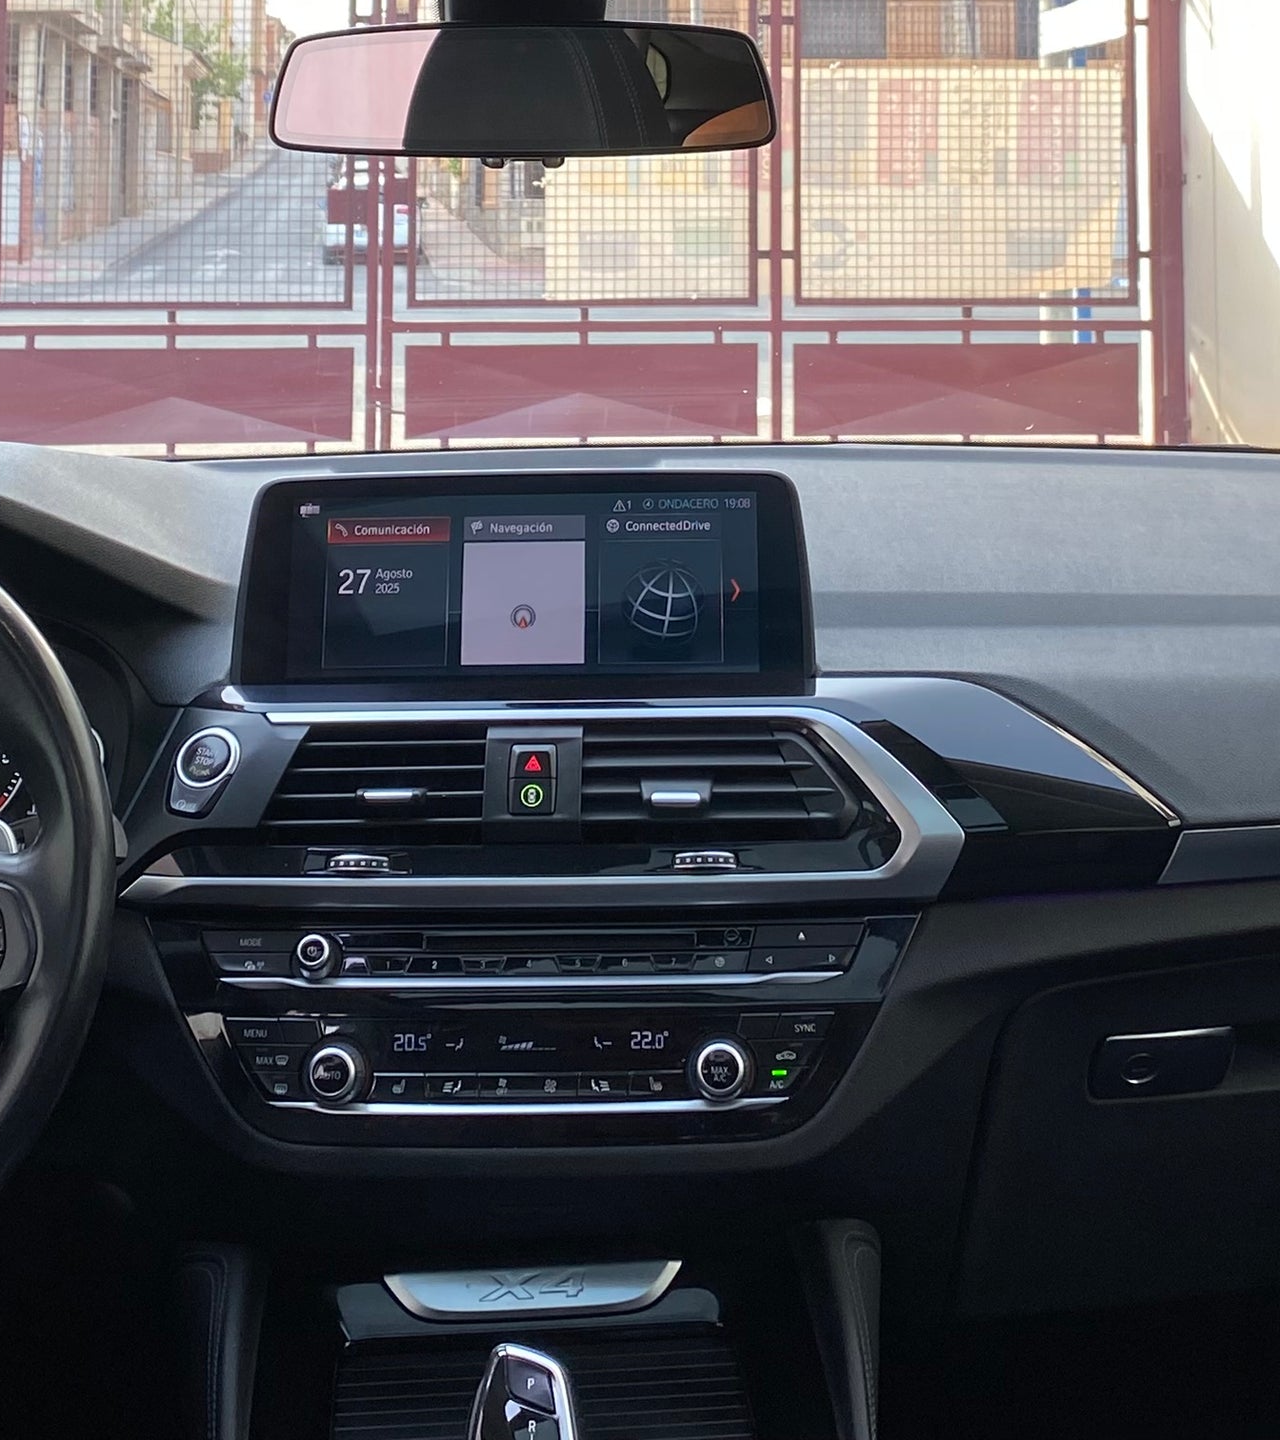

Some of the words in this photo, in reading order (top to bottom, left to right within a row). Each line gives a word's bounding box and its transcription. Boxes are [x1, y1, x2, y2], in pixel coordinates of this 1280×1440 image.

[658, 499, 718, 509] ONDACERO
[724, 498, 751, 509] 19:08
[354, 523, 430, 536] Comunicación
[490, 521, 553, 535] Navegación
[625, 520, 711, 532] ConnectedDrive
[375, 568, 413, 583] Agosto
[338, 569, 372, 595] 27
[375, 583, 400, 594] 2025
[240, 938, 262, 947] MODE
[432, 960, 438, 969] 2
[243, 1029, 268, 1038] MENU
[794, 1023, 816, 1033] SYNC
[256, 1056, 273, 1065] MAX
[479, 1271, 586, 1302] X4
[527, 1378, 535, 1390] P
[528, 1420, 536, 1433] R
